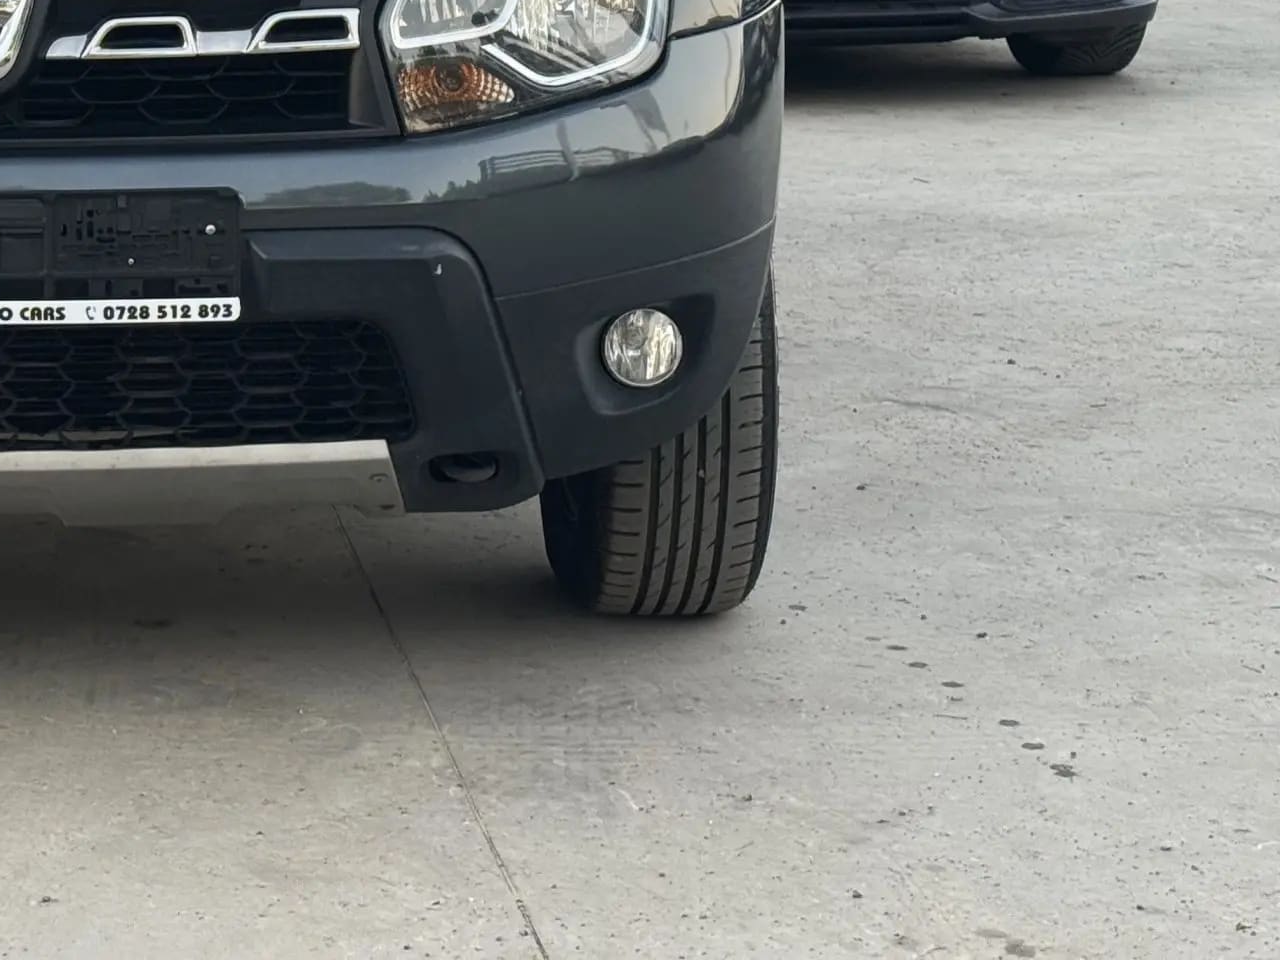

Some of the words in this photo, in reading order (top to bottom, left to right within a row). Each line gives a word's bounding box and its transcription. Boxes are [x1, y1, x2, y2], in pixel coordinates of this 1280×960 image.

[20, 307, 66, 321] CARS
[103, 306, 150, 320] 0728
[157, 305, 191, 319] 512
[198, 304, 233, 318] 893
